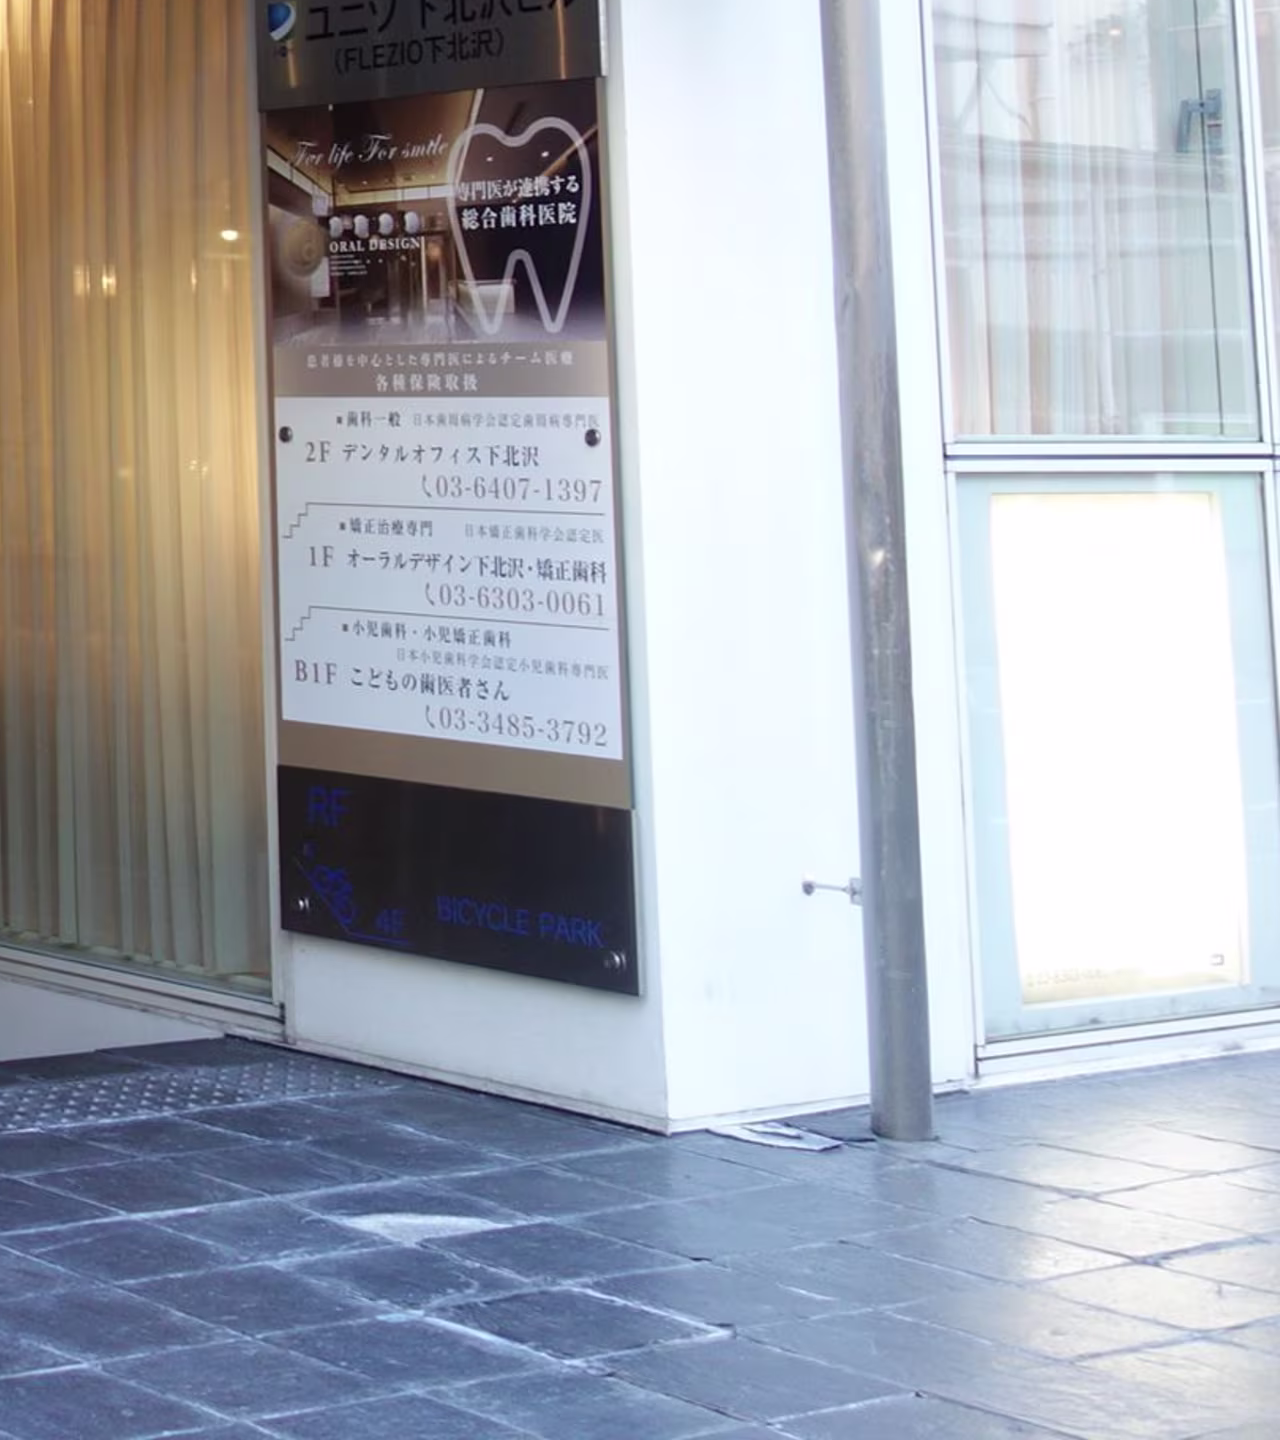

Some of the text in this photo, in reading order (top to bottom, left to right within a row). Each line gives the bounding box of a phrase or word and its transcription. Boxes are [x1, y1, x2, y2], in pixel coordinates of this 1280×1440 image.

[327, 143, 354, 169] life
[358, 134, 398, 162] For
[455, 174, 580, 202] 専門医が連携する
[461, 202, 578, 231] 総合歯科医院
[329, 236, 421, 253] ORAL DESIGN
[375, 372, 479, 392] 各種保険取扱
[346, 411, 401, 428] 歯科一般
[305, 441, 539, 468] 2F デンタルオフィス下北沢
[435, 475, 602, 502] 03-6407-1397
[349, 518, 433, 538] 矯正治療専門
[308, 546, 607, 585] 1F オーラルデザイン下北沢・矯正歯科
[438, 583, 606, 617] 03-6303-0061
[351, 619, 512, 649] 小児歯科・小児矯正歯科
[294, 660, 510, 702] B1F こどもの歯医者さん
[438, 707, 608, 748] 03-3485-3792
[436, 895, 530, 936] BICYCLE
[538, 910, 606, 949] PARK
